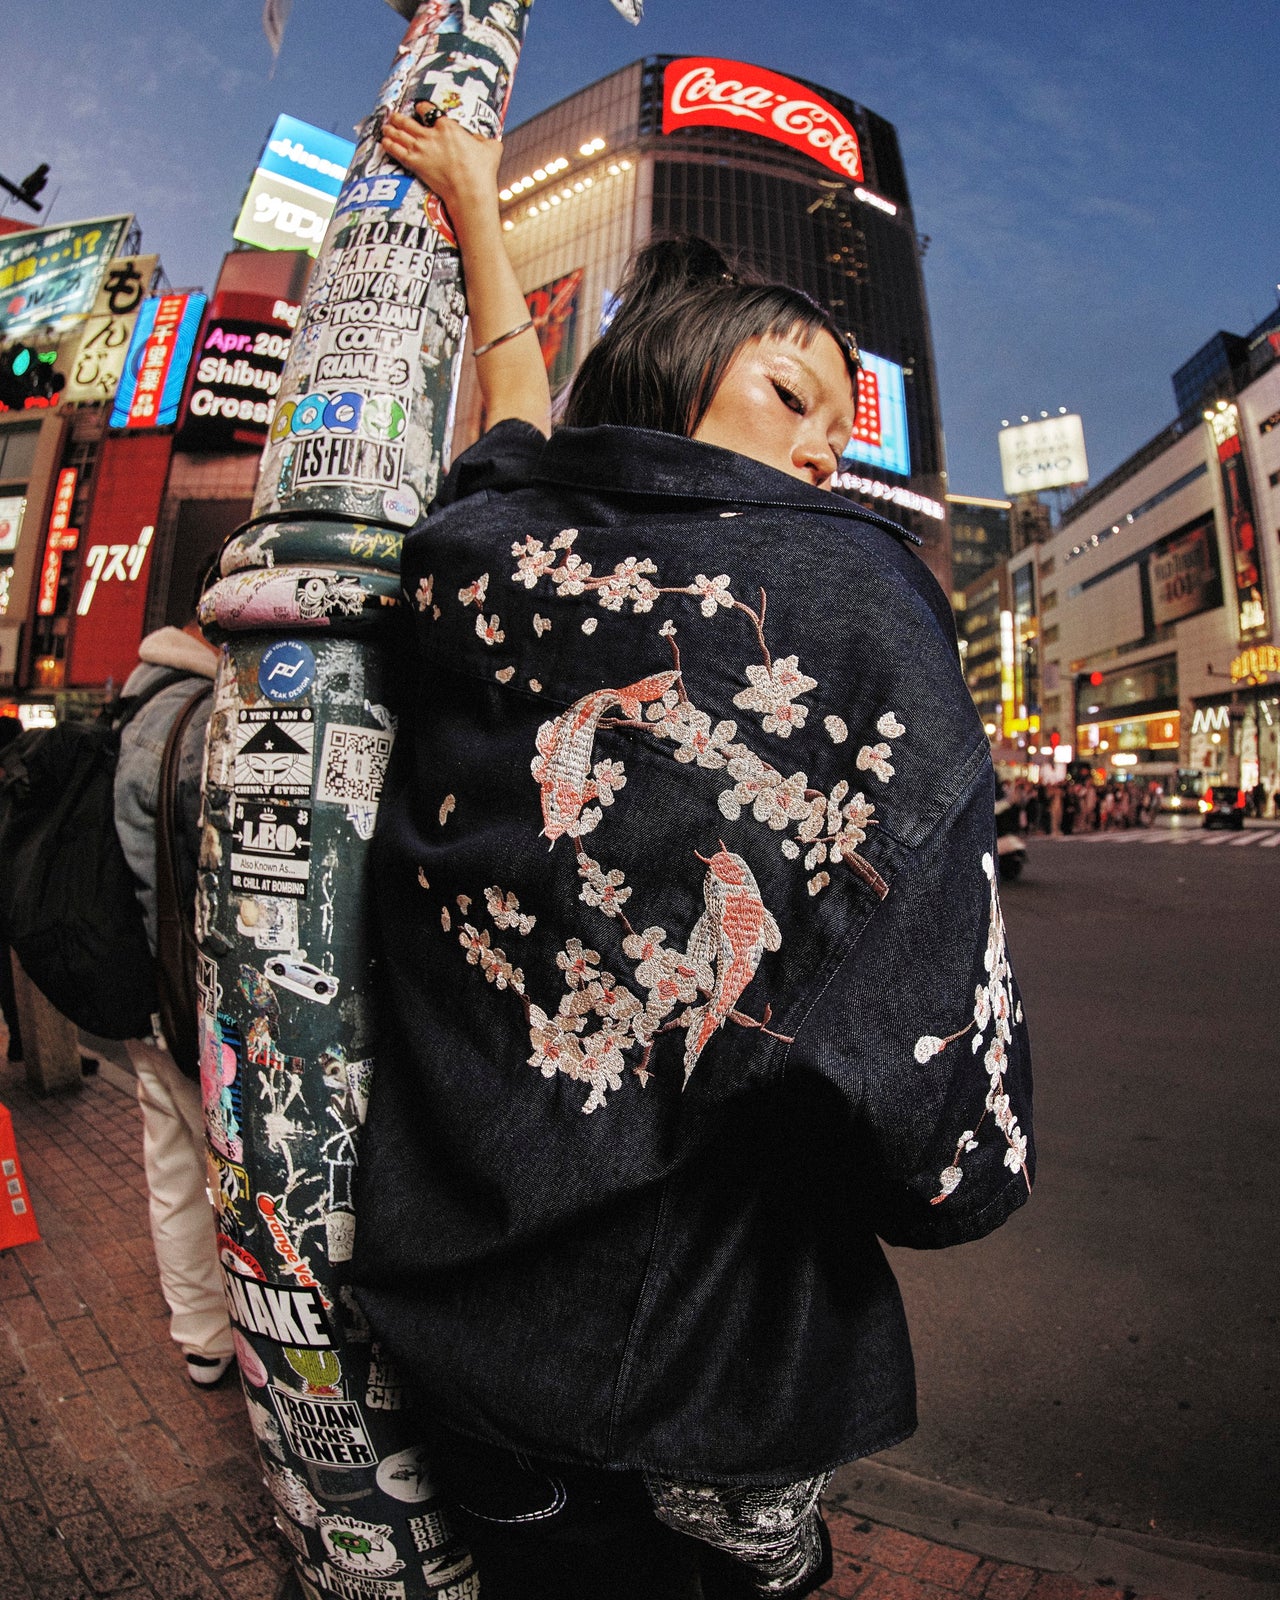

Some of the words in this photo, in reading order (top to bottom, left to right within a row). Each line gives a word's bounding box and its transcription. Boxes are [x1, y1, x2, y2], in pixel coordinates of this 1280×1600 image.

[671, 67, 859, 176] Coca-Cola
[347, 221, 438, 253] TROJAN
[76, 262, 143, 393] もんじゃ
[331, 300, 420, 331] TROJAN
[132, 299, 181, 417] 三千里薬品
[197, 357, 281, 395] Shibuy
[191, 389, 276, 424] Crossi
[77, 526, 154, 615] クスリ
[272, 641, 287, 651] YOUR
[288, 641, 303, 650] PEAK
[270, 689, 287, 699] PEAK
[288, 677, 310, 697] DESIGN
[280, 711, 298, 720] AM
[243, 821, 297, 852] LEO
[240, 859, 254, 869] Also
[254, 861, 278, 872] Known
[243, 876, 260, 890] CHILL
[261, 879, 271, 891] AT
[272, 880, 305, 895] BOMBING
[275, 1391, 359, 1428] TROJAN
[290, 1431, 372, 1464] FINER
